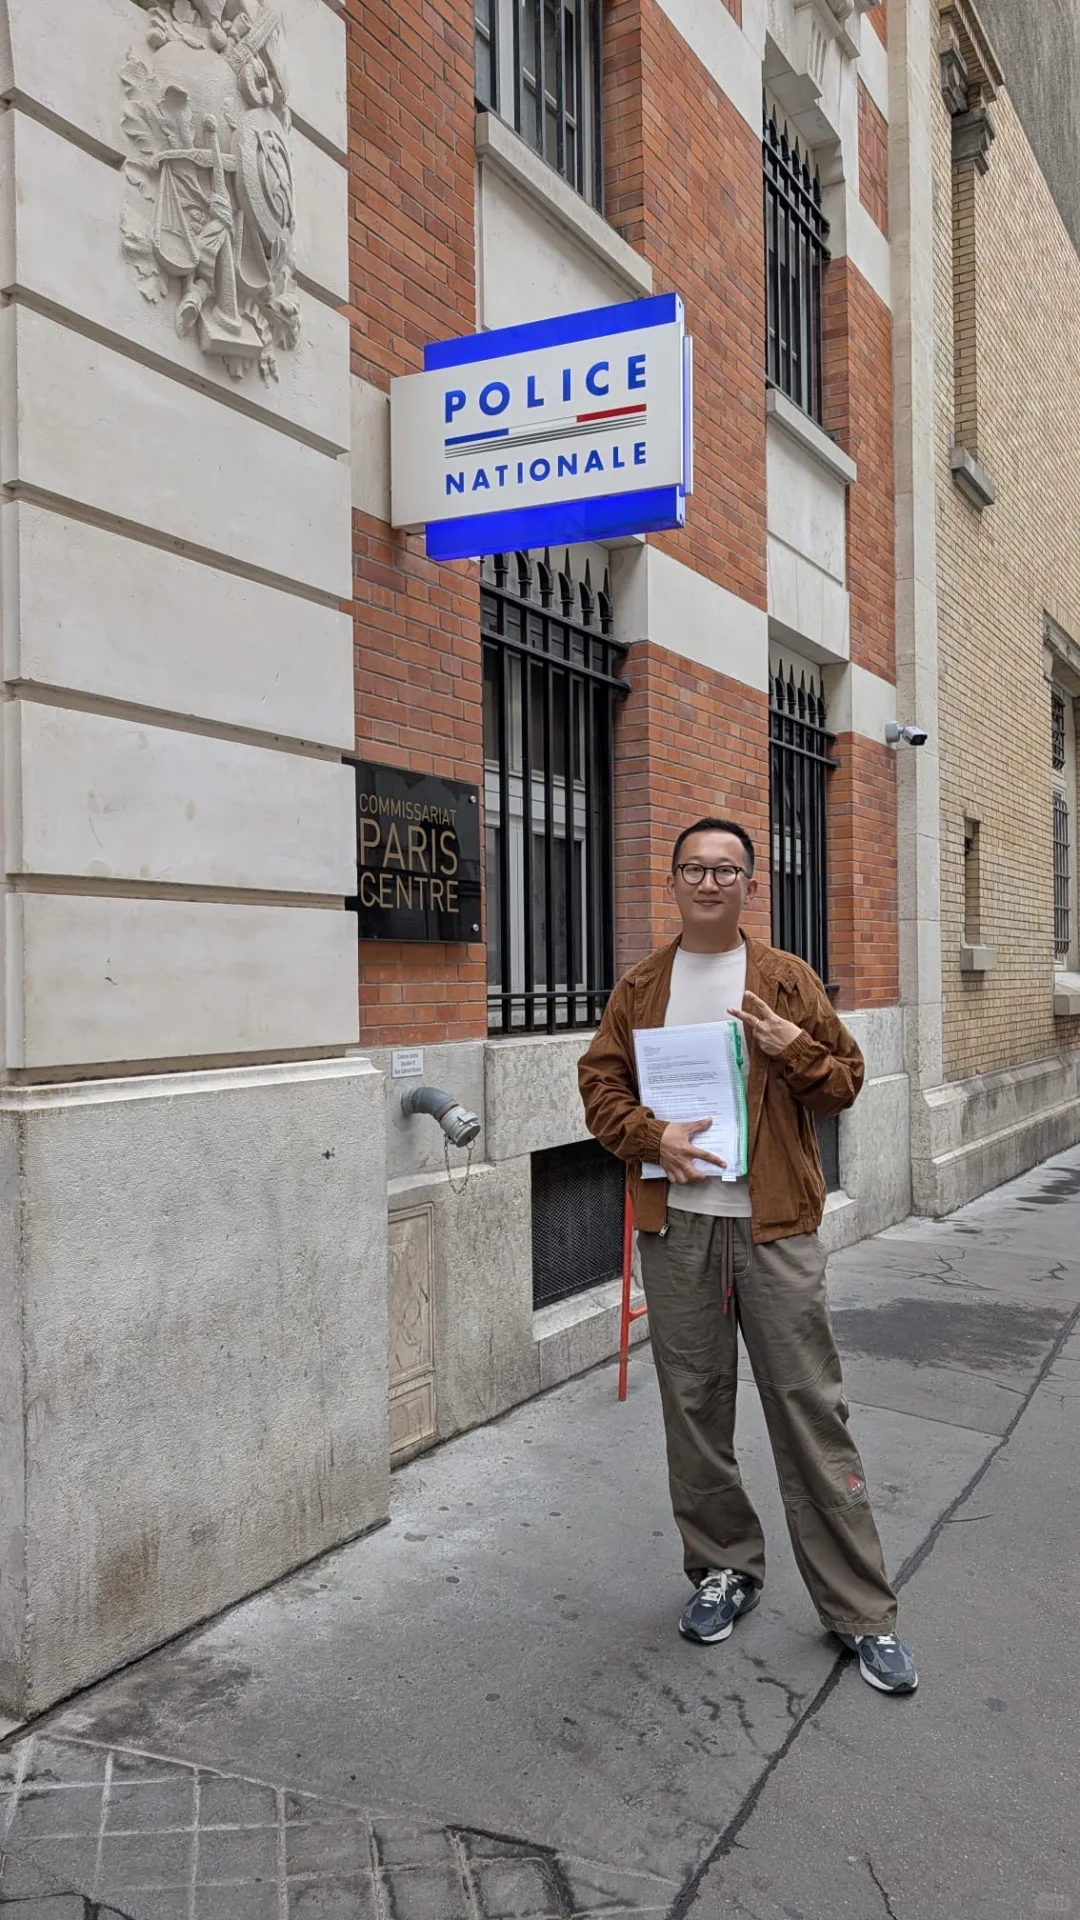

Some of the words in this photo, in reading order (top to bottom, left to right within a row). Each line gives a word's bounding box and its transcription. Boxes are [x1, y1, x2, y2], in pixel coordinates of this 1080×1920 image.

[445, 354, 646, 423] POLICE
[445, 442, 646, 495] NATIONALE
[359, 793, 457, 826] COMMISSARIAT
[359, 817, 458, 876] PARIS
[360, 872, 459, 913] CENTRE
